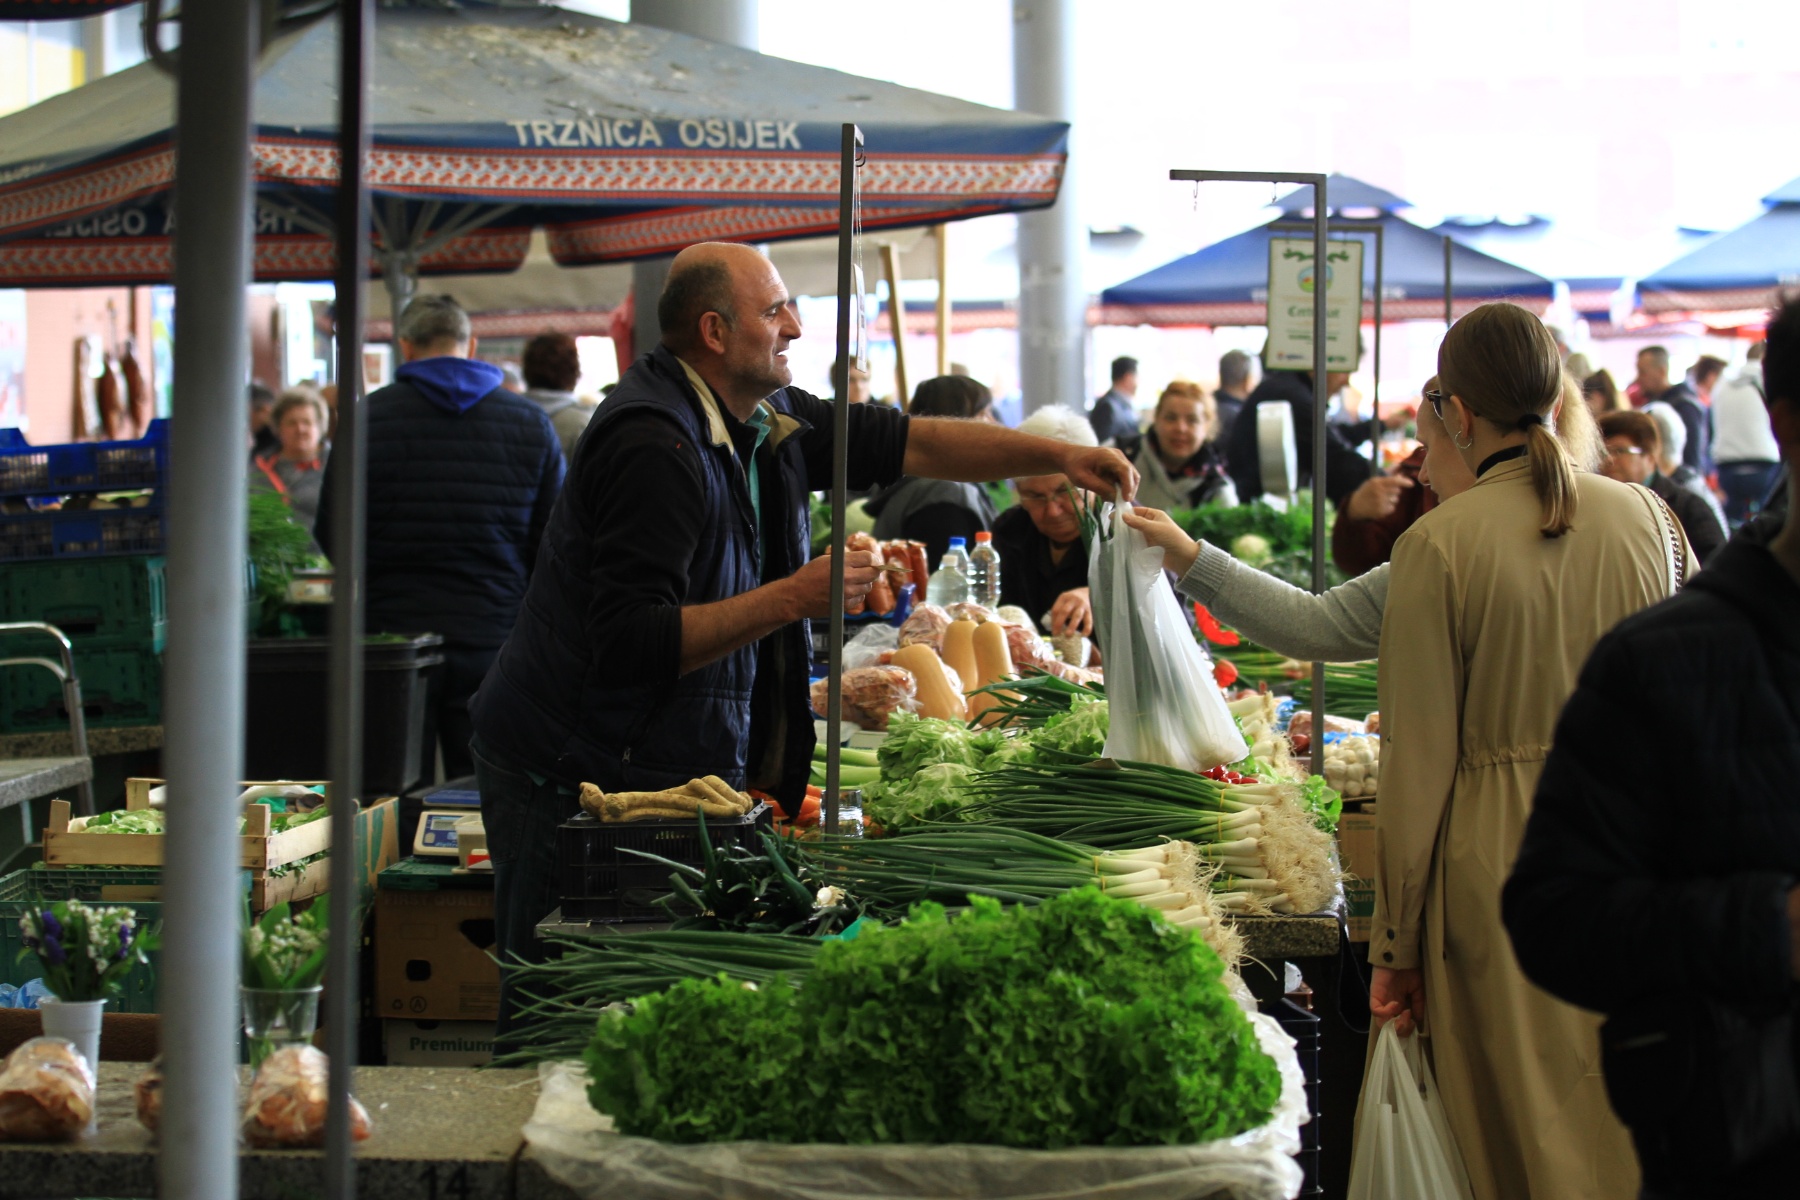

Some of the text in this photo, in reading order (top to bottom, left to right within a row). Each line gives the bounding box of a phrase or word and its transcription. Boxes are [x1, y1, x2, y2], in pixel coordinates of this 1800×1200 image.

[678, 120, 801, 149] OSIJEK
[384, 894, 493, 908] FIRST QUALIT
